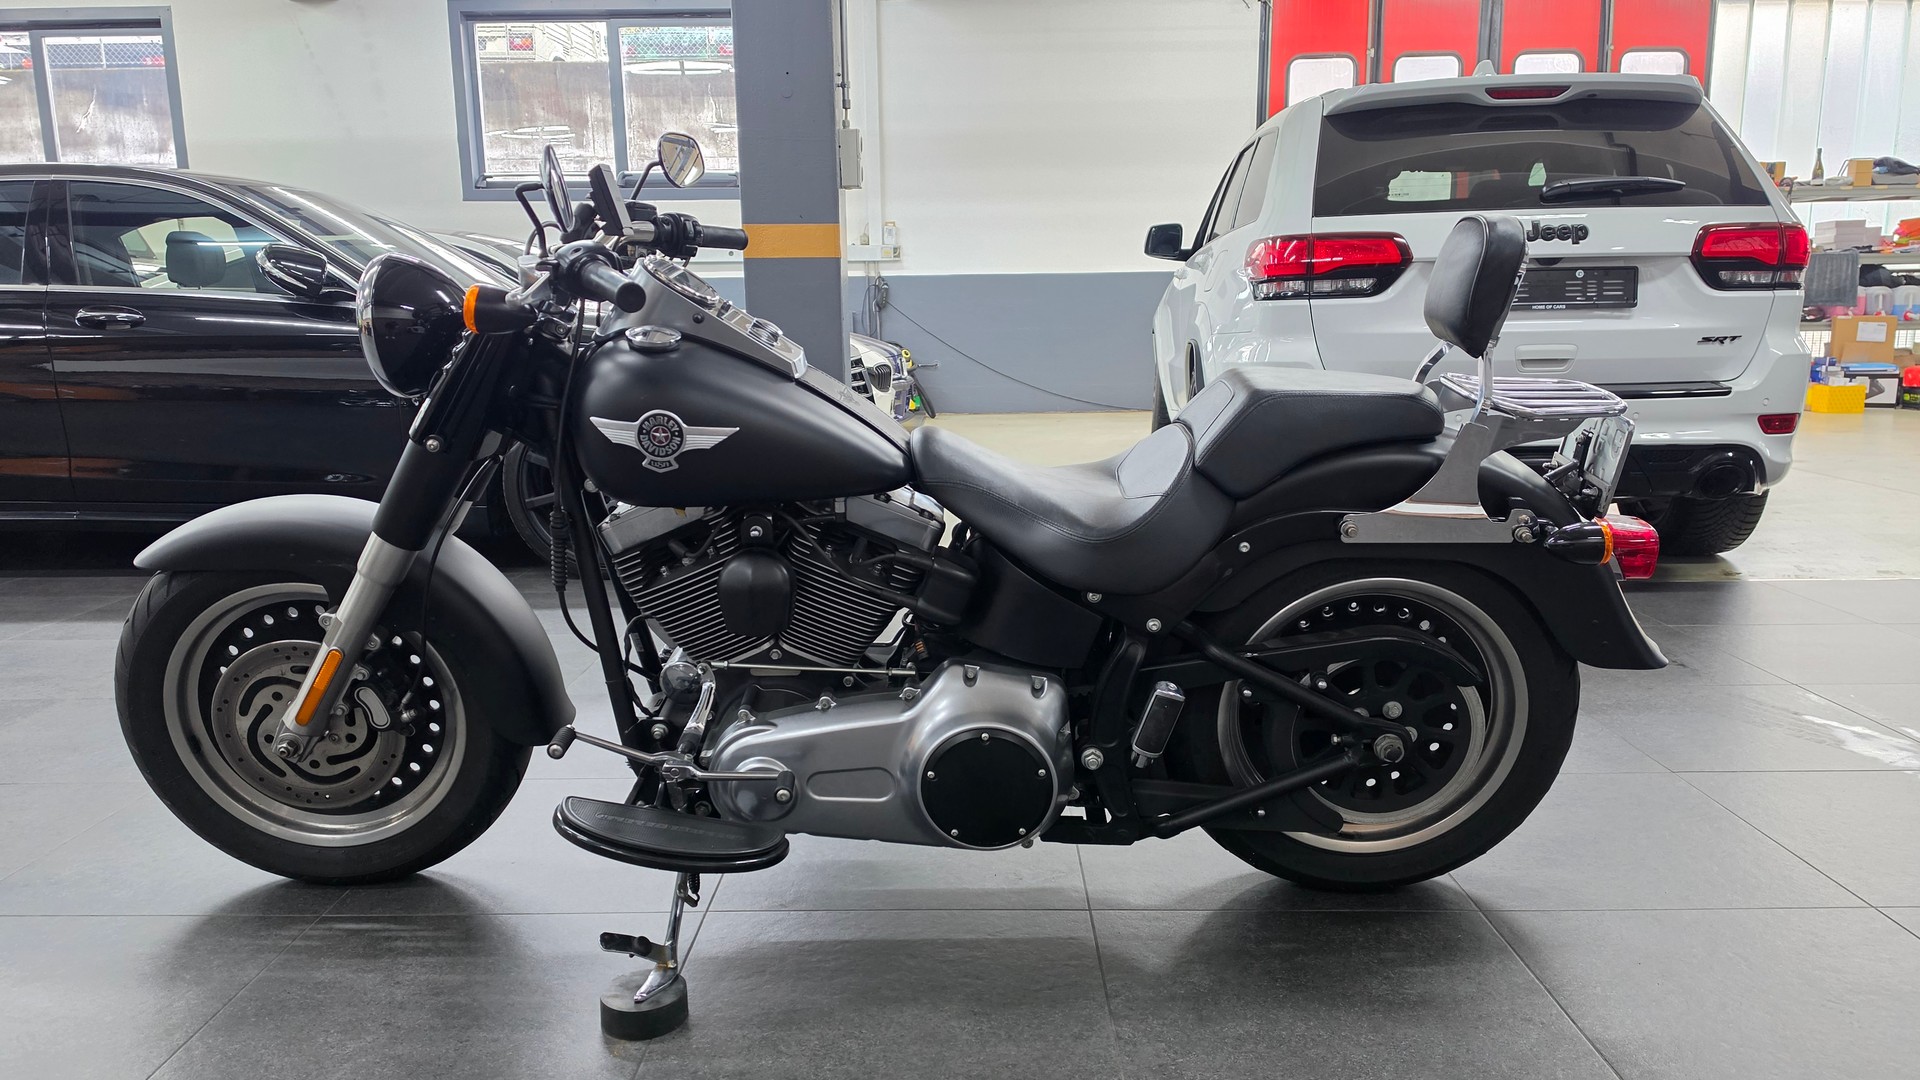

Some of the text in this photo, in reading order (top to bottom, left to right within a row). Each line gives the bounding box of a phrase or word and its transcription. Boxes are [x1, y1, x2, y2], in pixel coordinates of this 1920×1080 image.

[1526, 220, 1589, 245] Jeep
[1697, 335, 1743, 345] SRT
[641, 415, 679, 431] HARLEY
[640, 434, 681, 455] DAVIDSON
